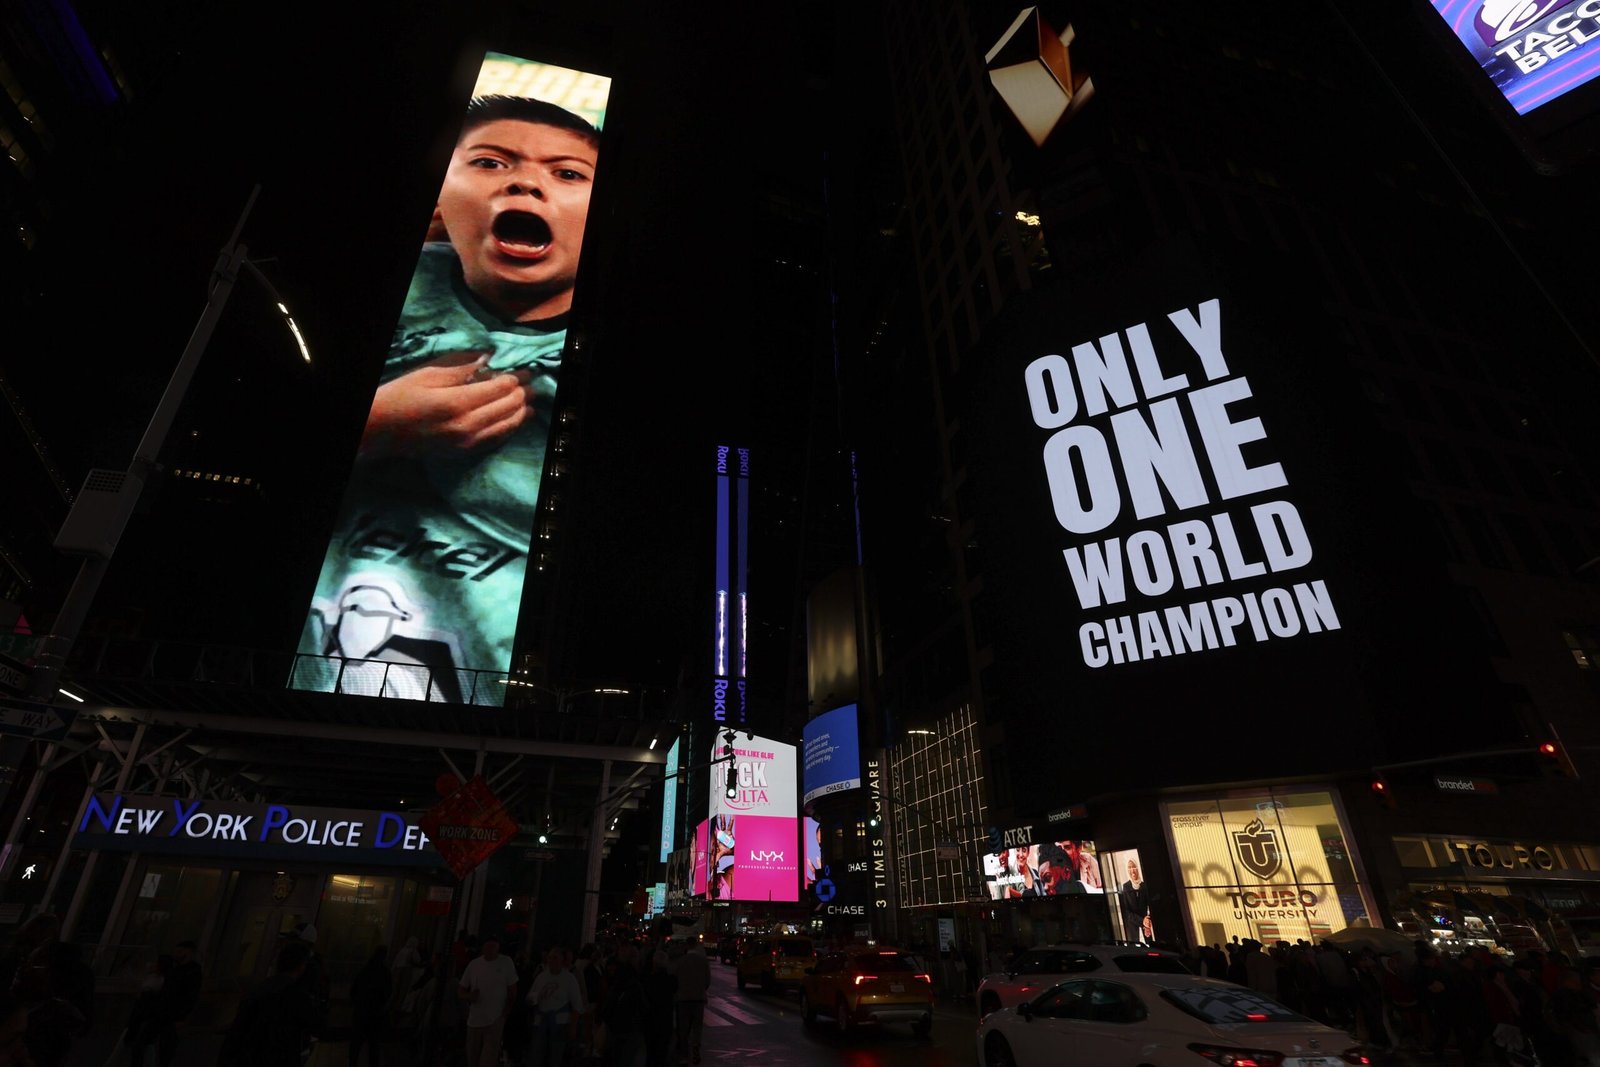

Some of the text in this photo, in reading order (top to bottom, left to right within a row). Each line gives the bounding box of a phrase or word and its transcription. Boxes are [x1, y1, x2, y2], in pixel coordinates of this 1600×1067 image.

[1495, 0, 1600, 61] TACO
[1515, 16, 1600, 74] BEL
[1025, 298, 1230, 429] ONLY
[1043, 376, 1289, 534] ONE
[1062, 500, 1313, 610] WORLD
[1079, 580, 1341, 668] CHAMPION
[826, 782, 844, 793] CHASE
[1437, 778, 1475, 791] branded
[79, 794, 165, 835] NEW
[168, 799, 254, 841] YORK
[259, 804, 364, 848] POLICE
[1048, 809, 1071, 822] branded
[1172, 814, 1210, 823] cross river
[438, 824, 498, 841] WORK ZONE
[1173, 821, 1203, 829] campus
[1003, 826, 1033, 848] AT&T
[751, 850, 784, 862] NYX
[873, 839, 886, 888] TIMES
[876, 899, 887, 908] 3
[1226, 889, 1318, 909] TOURO
[827, 905, 865, 915] CHASE
[1234, 909, 1318, 920] UNIVERSITY
